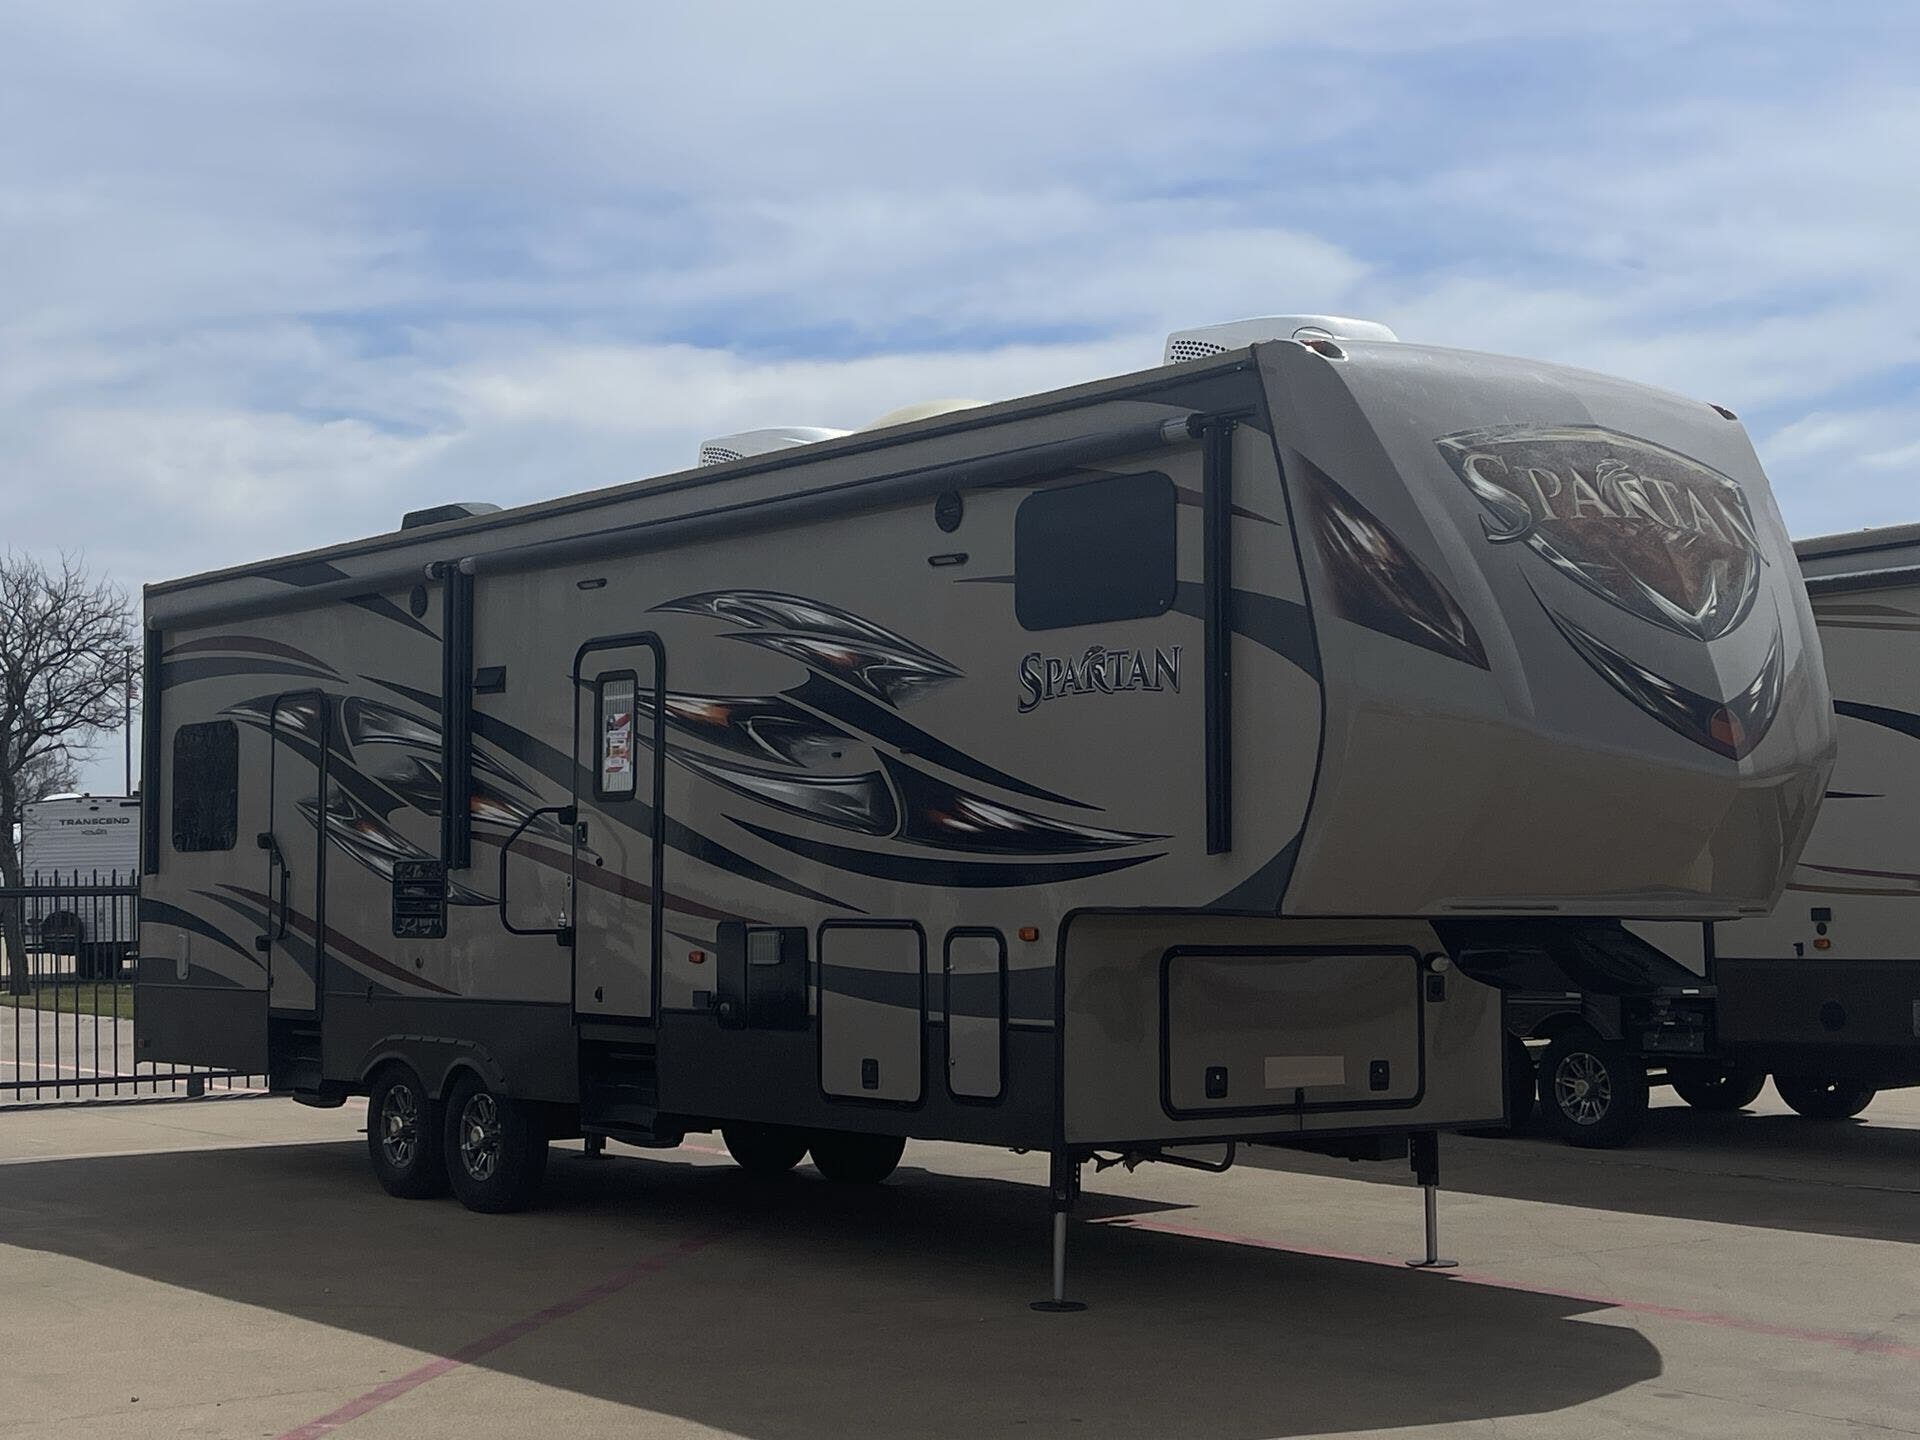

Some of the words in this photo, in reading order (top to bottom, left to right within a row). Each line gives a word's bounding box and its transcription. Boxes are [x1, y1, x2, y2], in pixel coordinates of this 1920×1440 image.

[1462, 452, 1770, 567] SPARTAN
[1017, 645, 1183, 713] SPARTAN
[59, 816, 130, 826] TRANSCEND
